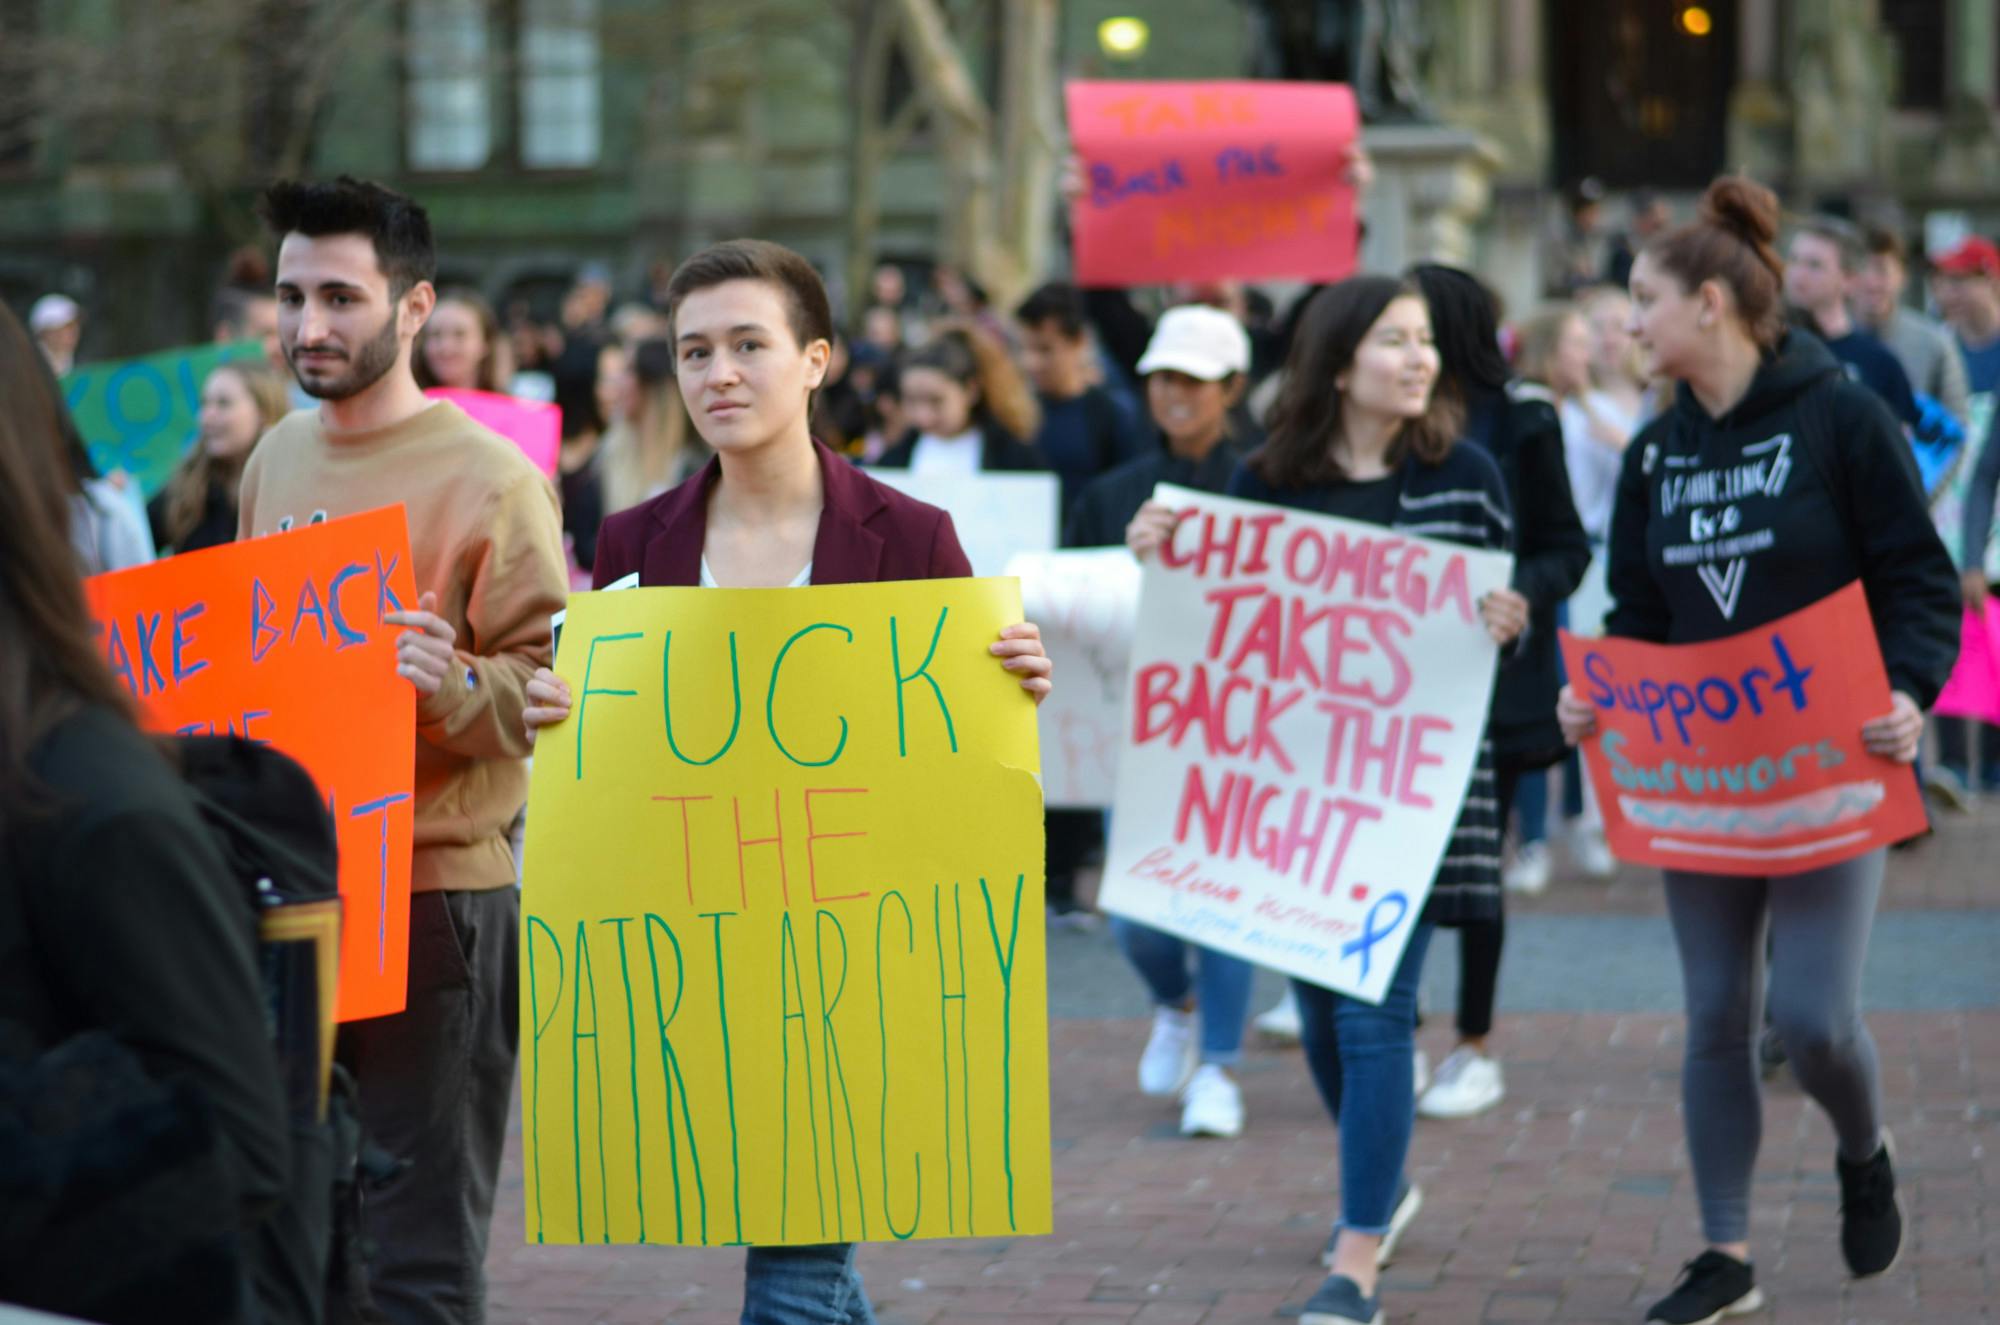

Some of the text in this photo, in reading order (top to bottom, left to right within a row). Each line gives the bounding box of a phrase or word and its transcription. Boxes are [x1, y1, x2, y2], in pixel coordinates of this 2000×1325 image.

[250, 548, 405, 663] BACK
[1160, 507, 1474, 622] CHI OMEGA
[575, 606, 958, 780] FUCK
[1206, 584, 1412, 707] TAKES
[1584, 633, 1815, 746] Support
[1131, 661, 1304, 774] BACK
[1317, 699, 1454, 809] THE
[1600, 728, 1845, 795] Survivors
[651, 788, 872, 910] THE
[1174, 764, 1383, 901] NIGHT.
[527, 874, 1025, 1247] PATRIARCHY
